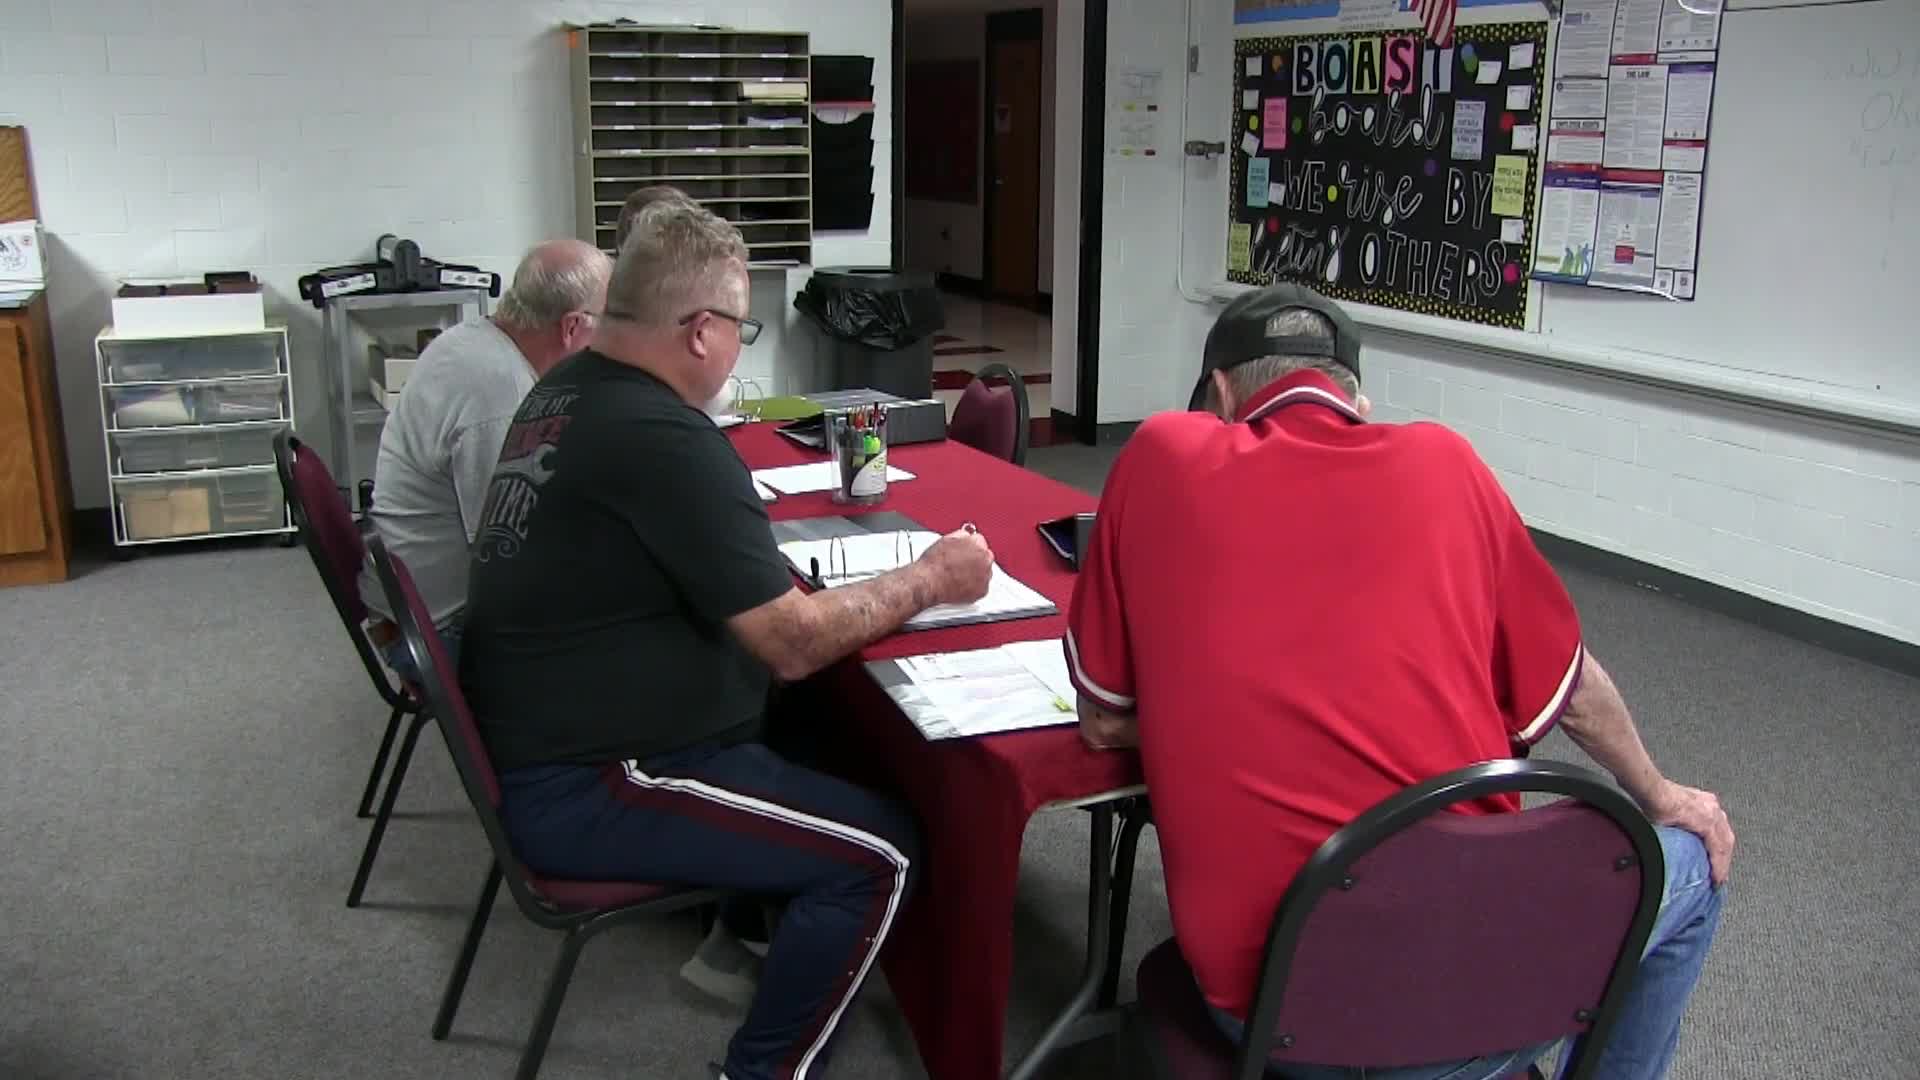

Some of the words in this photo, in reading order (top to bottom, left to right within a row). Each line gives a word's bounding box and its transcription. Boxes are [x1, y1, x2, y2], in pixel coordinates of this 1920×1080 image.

[1296, 36, 1453, 92] BOAST
[1308, 83, 1445, 149] board
[1284, 160, 1325, 213] WE
[1337, 161, 1423, 228] rise
[1445, 167, 1493, 230] BY
[1358, 230, 1507, 307] OTHERS
